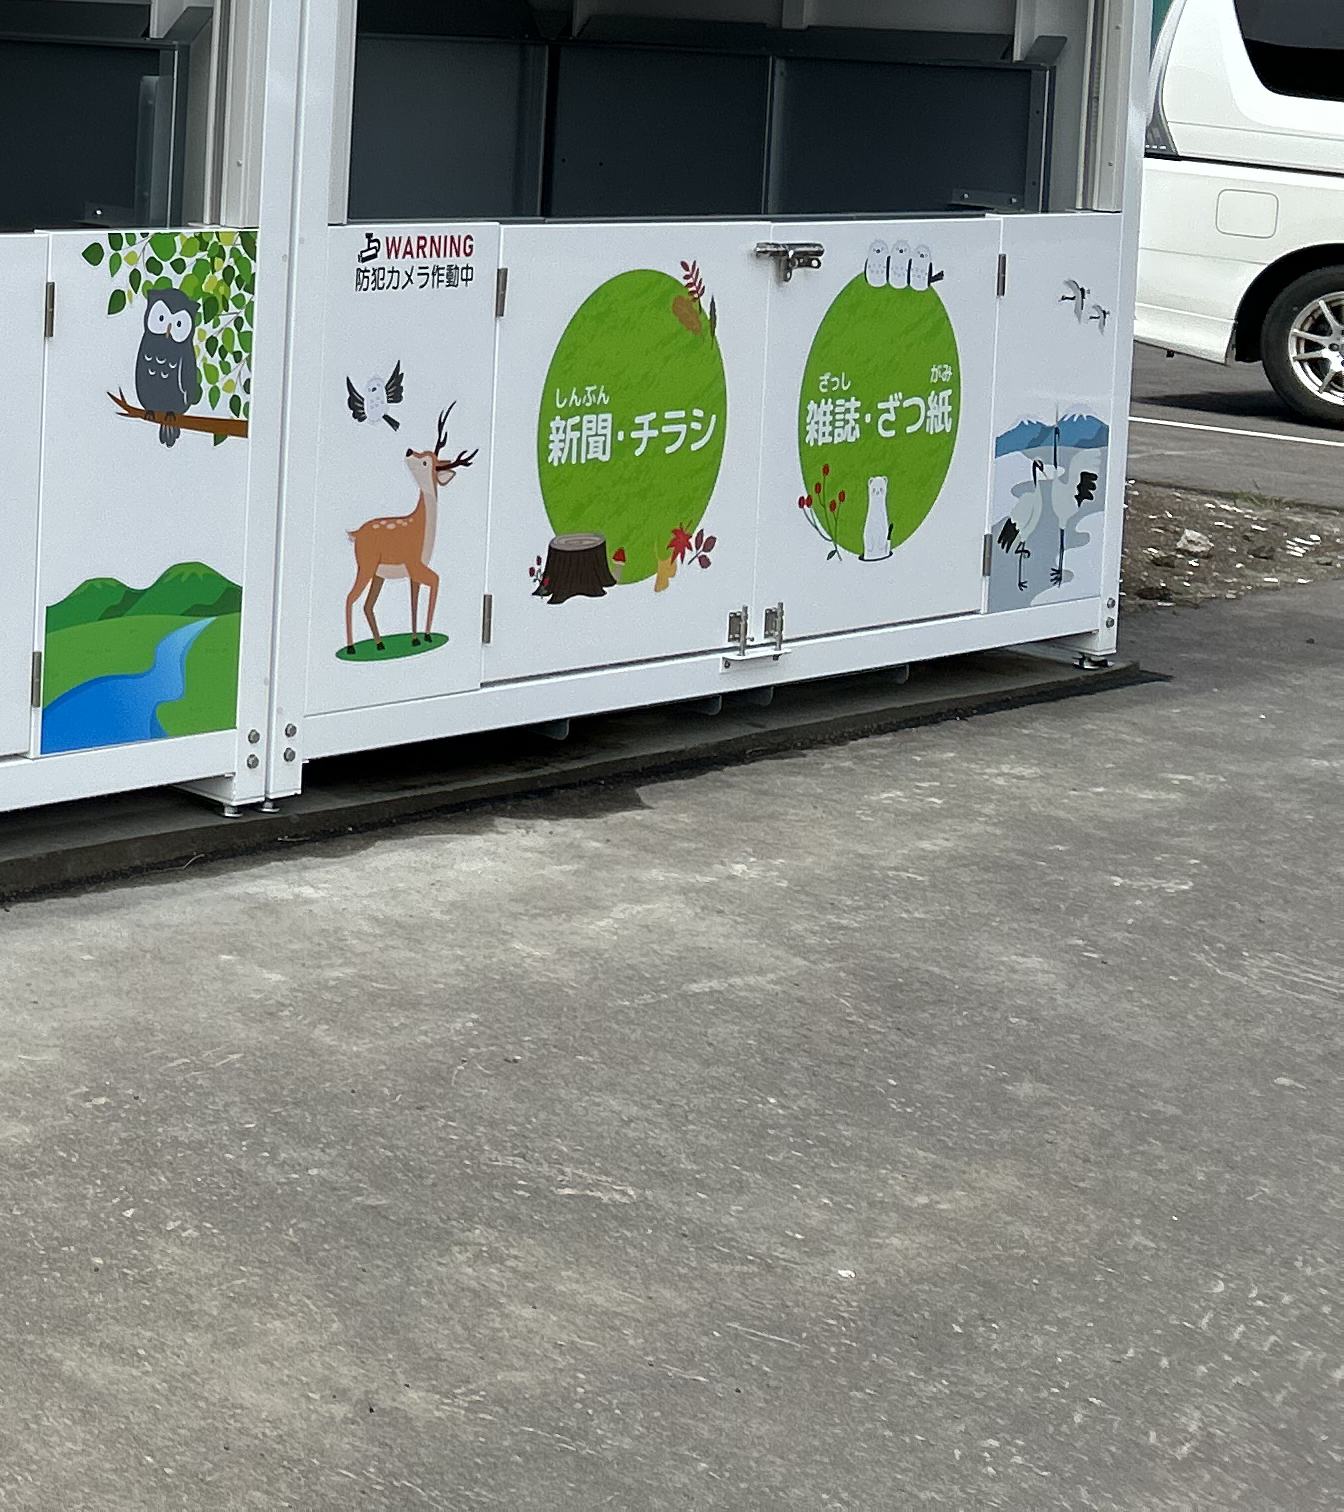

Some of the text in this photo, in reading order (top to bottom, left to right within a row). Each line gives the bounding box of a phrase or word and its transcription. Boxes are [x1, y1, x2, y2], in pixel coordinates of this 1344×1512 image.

[385, 234, 474, 260] WARNING
[355, 264, 474, 292] 防犯カメラ作動中
[818, 371, 851, 393] ざっし
[930, 364, 953, 383] がみ
[556, 385, 610, 409] しんぶん
[805, 389, 953, 447] 雑誌・ざつ紙
[547, 408, 717, 466] 新聞・チラシ
